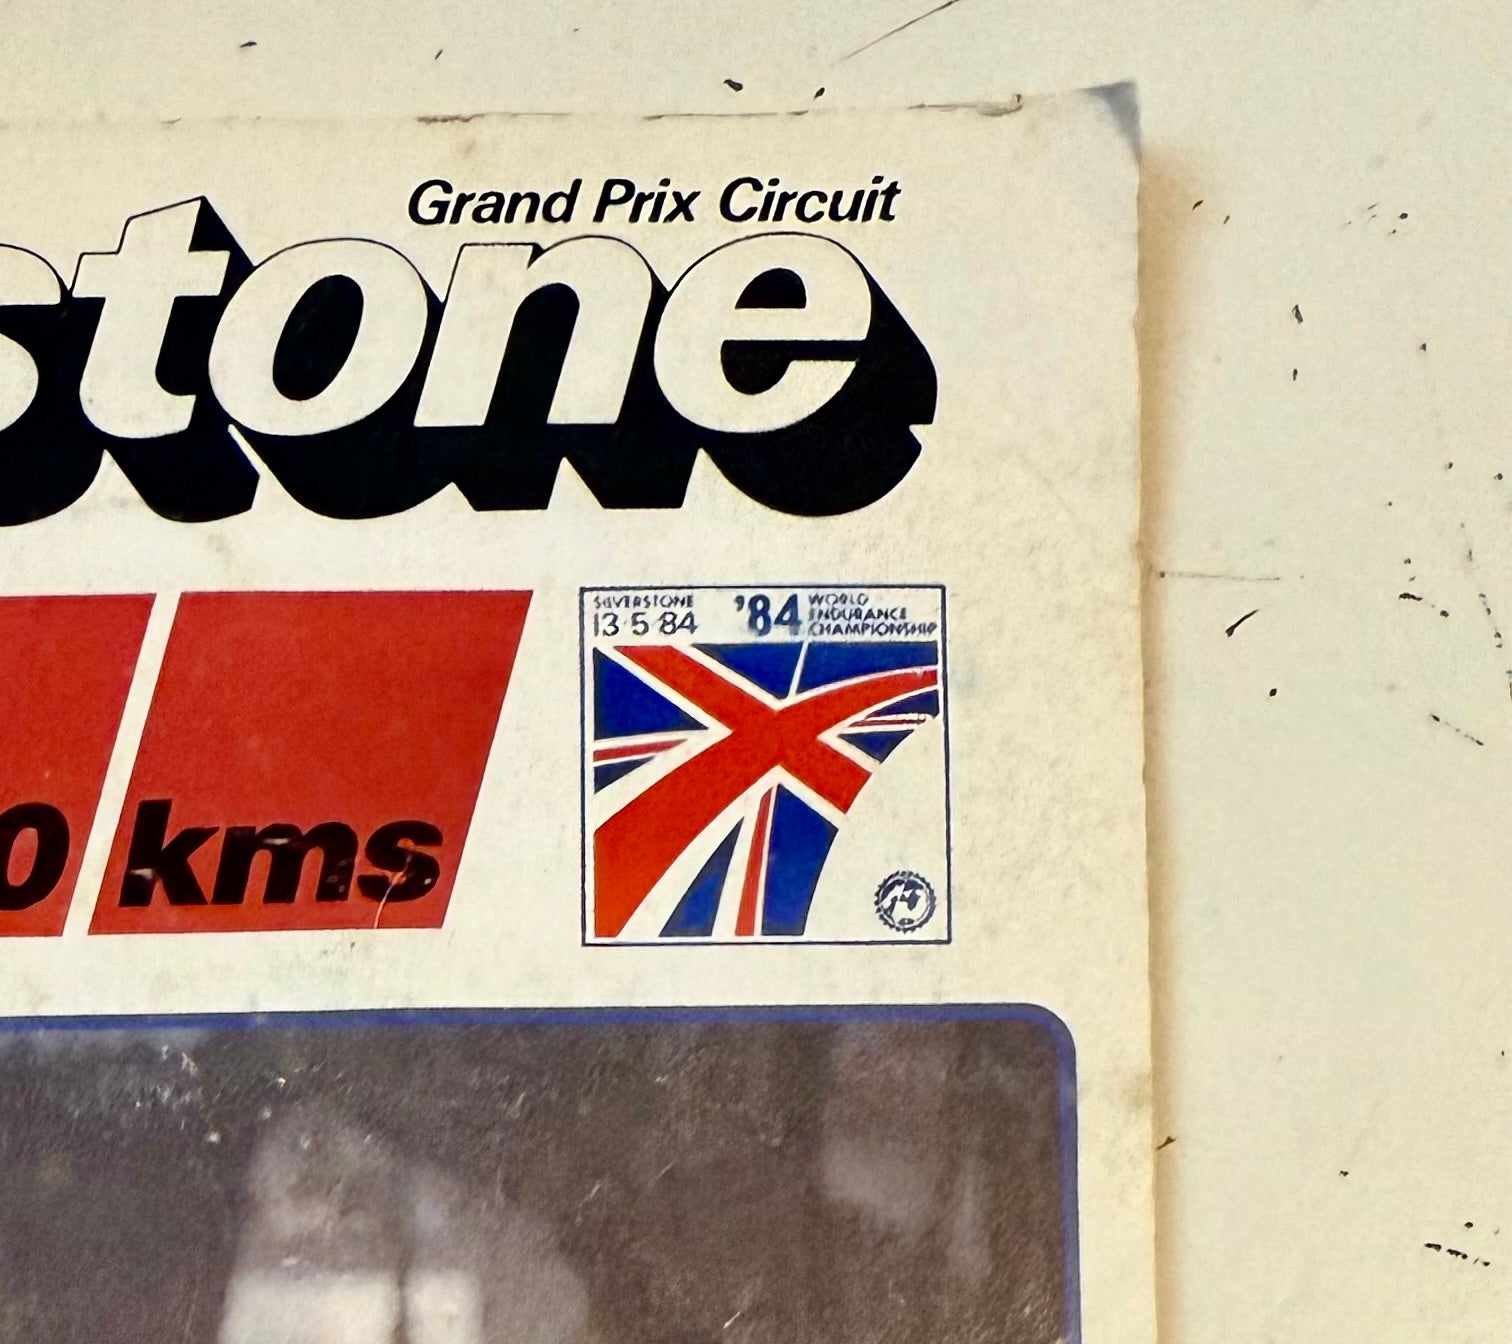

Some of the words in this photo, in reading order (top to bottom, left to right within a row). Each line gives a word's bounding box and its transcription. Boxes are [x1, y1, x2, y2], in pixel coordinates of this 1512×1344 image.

[409, 179, 582, 225] Grand
[593, 178, 700, 223] Prix
[720, 175, 901, 223] Circuit
[808, 594, 869, 607] WORLD
[808, 606, 908, 621] ENDURANCE
[807, 621, 939, 637] CHAMPIONSHIP
[118, 798, 445, 910] kms
